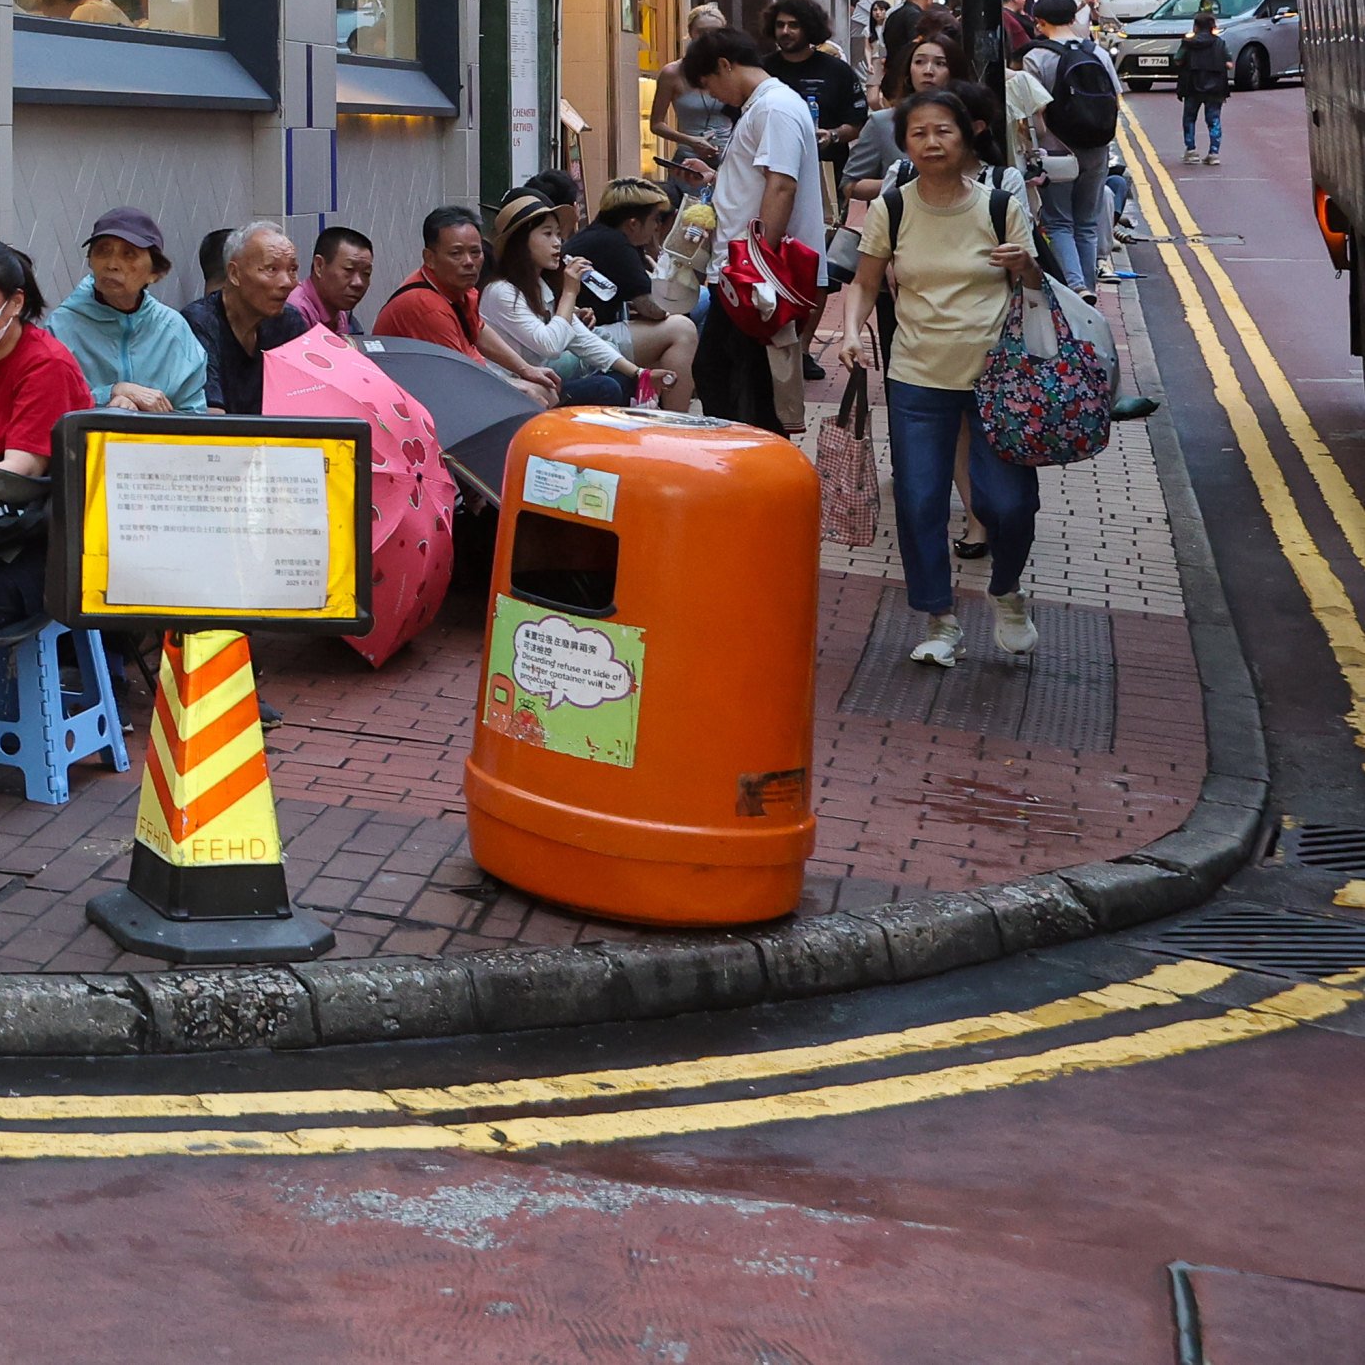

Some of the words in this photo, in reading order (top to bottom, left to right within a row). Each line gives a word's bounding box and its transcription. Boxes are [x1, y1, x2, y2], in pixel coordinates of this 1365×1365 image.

[522, 651, 556, 669] Discarding
[557, 662, 581, 674] refuse
[582, 668, 591, 676] at
[592, 670, 611, 679] side
[612, 672, 622, 681] of
[549, 670, 586, 684] container
[605, 681, 616, 691] be
[139, 815, 170, 855] FEHD
[192, 838, 267, 861] FEHD
